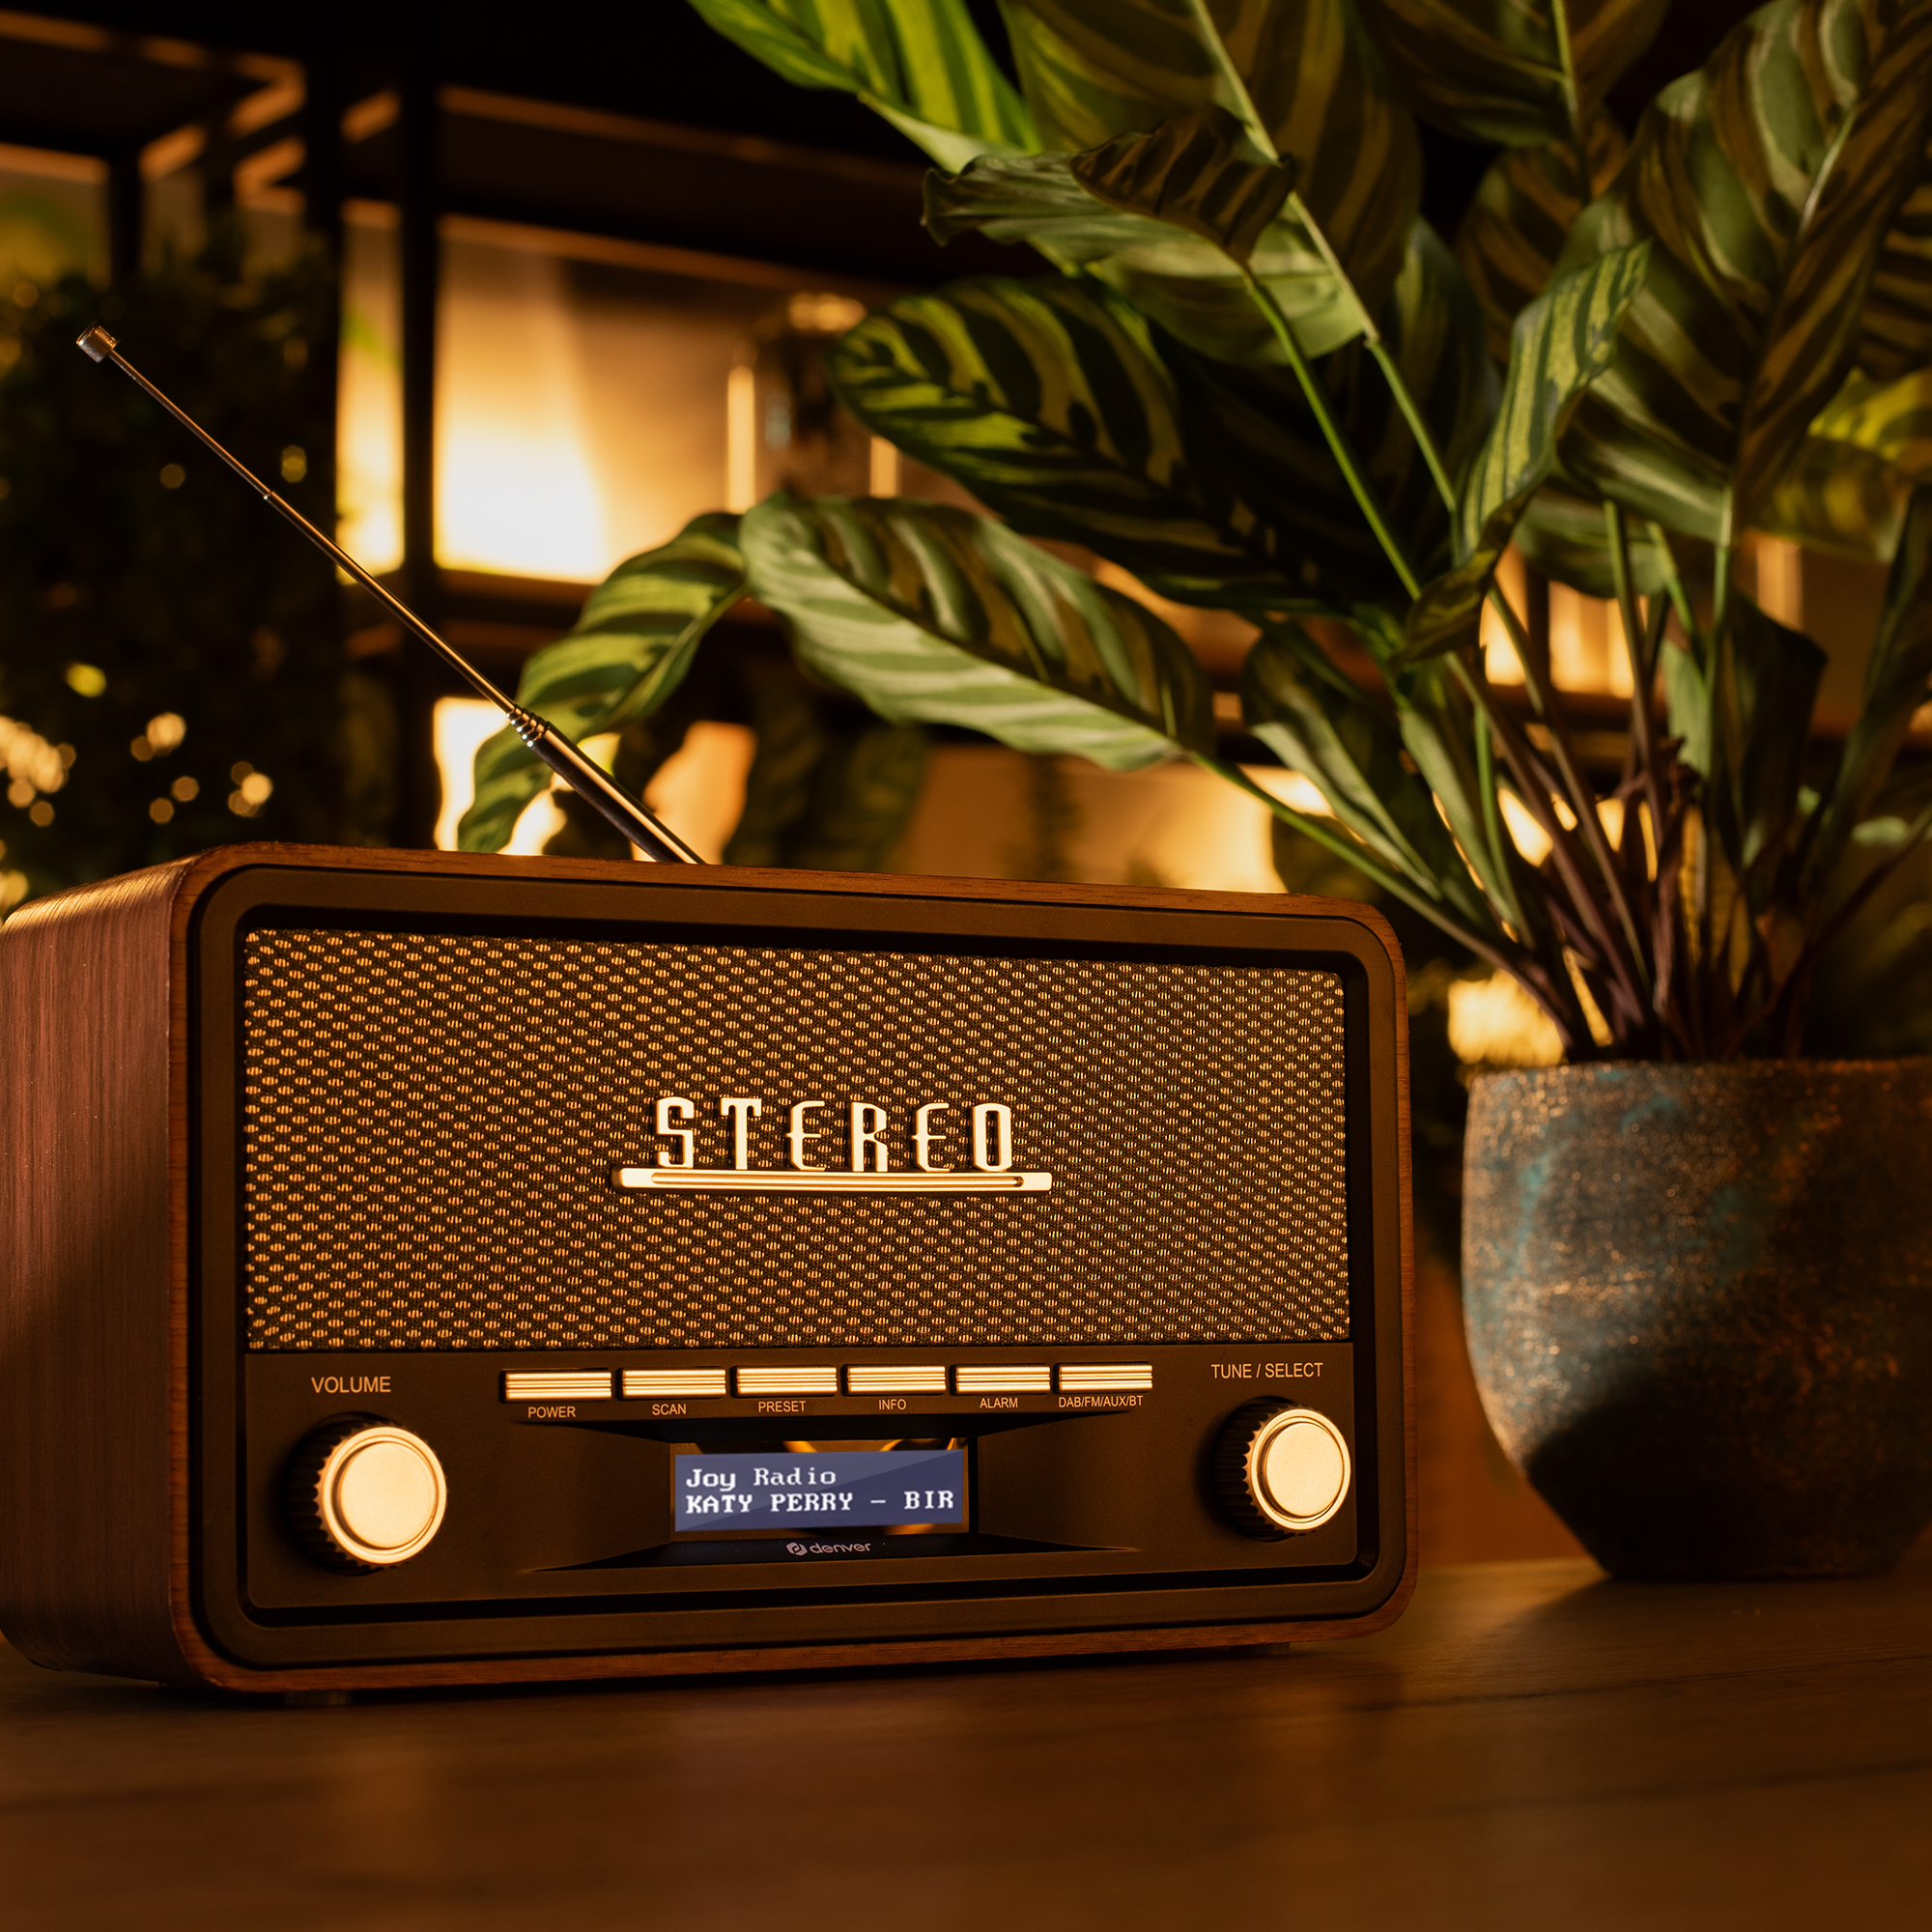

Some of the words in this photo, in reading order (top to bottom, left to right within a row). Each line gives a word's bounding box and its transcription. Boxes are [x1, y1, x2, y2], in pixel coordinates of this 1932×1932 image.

[654, 1095, 1013, 1173] STEREO
[1210, 1363, 1253, 1379] TUNE
[1255, 1363, 1262, 1378] /
[1264, 1362, 1324, 1378] SELECT
[310, 1376, 392, 1394] VOLUME
[757, 1400, 807, 1413] PRESET
[878, 1399, 907, 1410] INFO
[980, 1397, 1019, 1409] ALARM
[1058, 1395, 1144, 1407] DAB/FM/AUX/BT
[527, 1406, 577, 1419] POWER
[651, 1403, 687, 1416] SCAN
[685, 1468, 736, 1492] Joy
[753, 1466, 837, 1486] Radio
[685, 1493, 753, 1514] KATY
[769, 1492, 854, 1513] PERRY
[903, 1490, 954, 1510] BIR
[809, 1543, 871, 1554] denver
